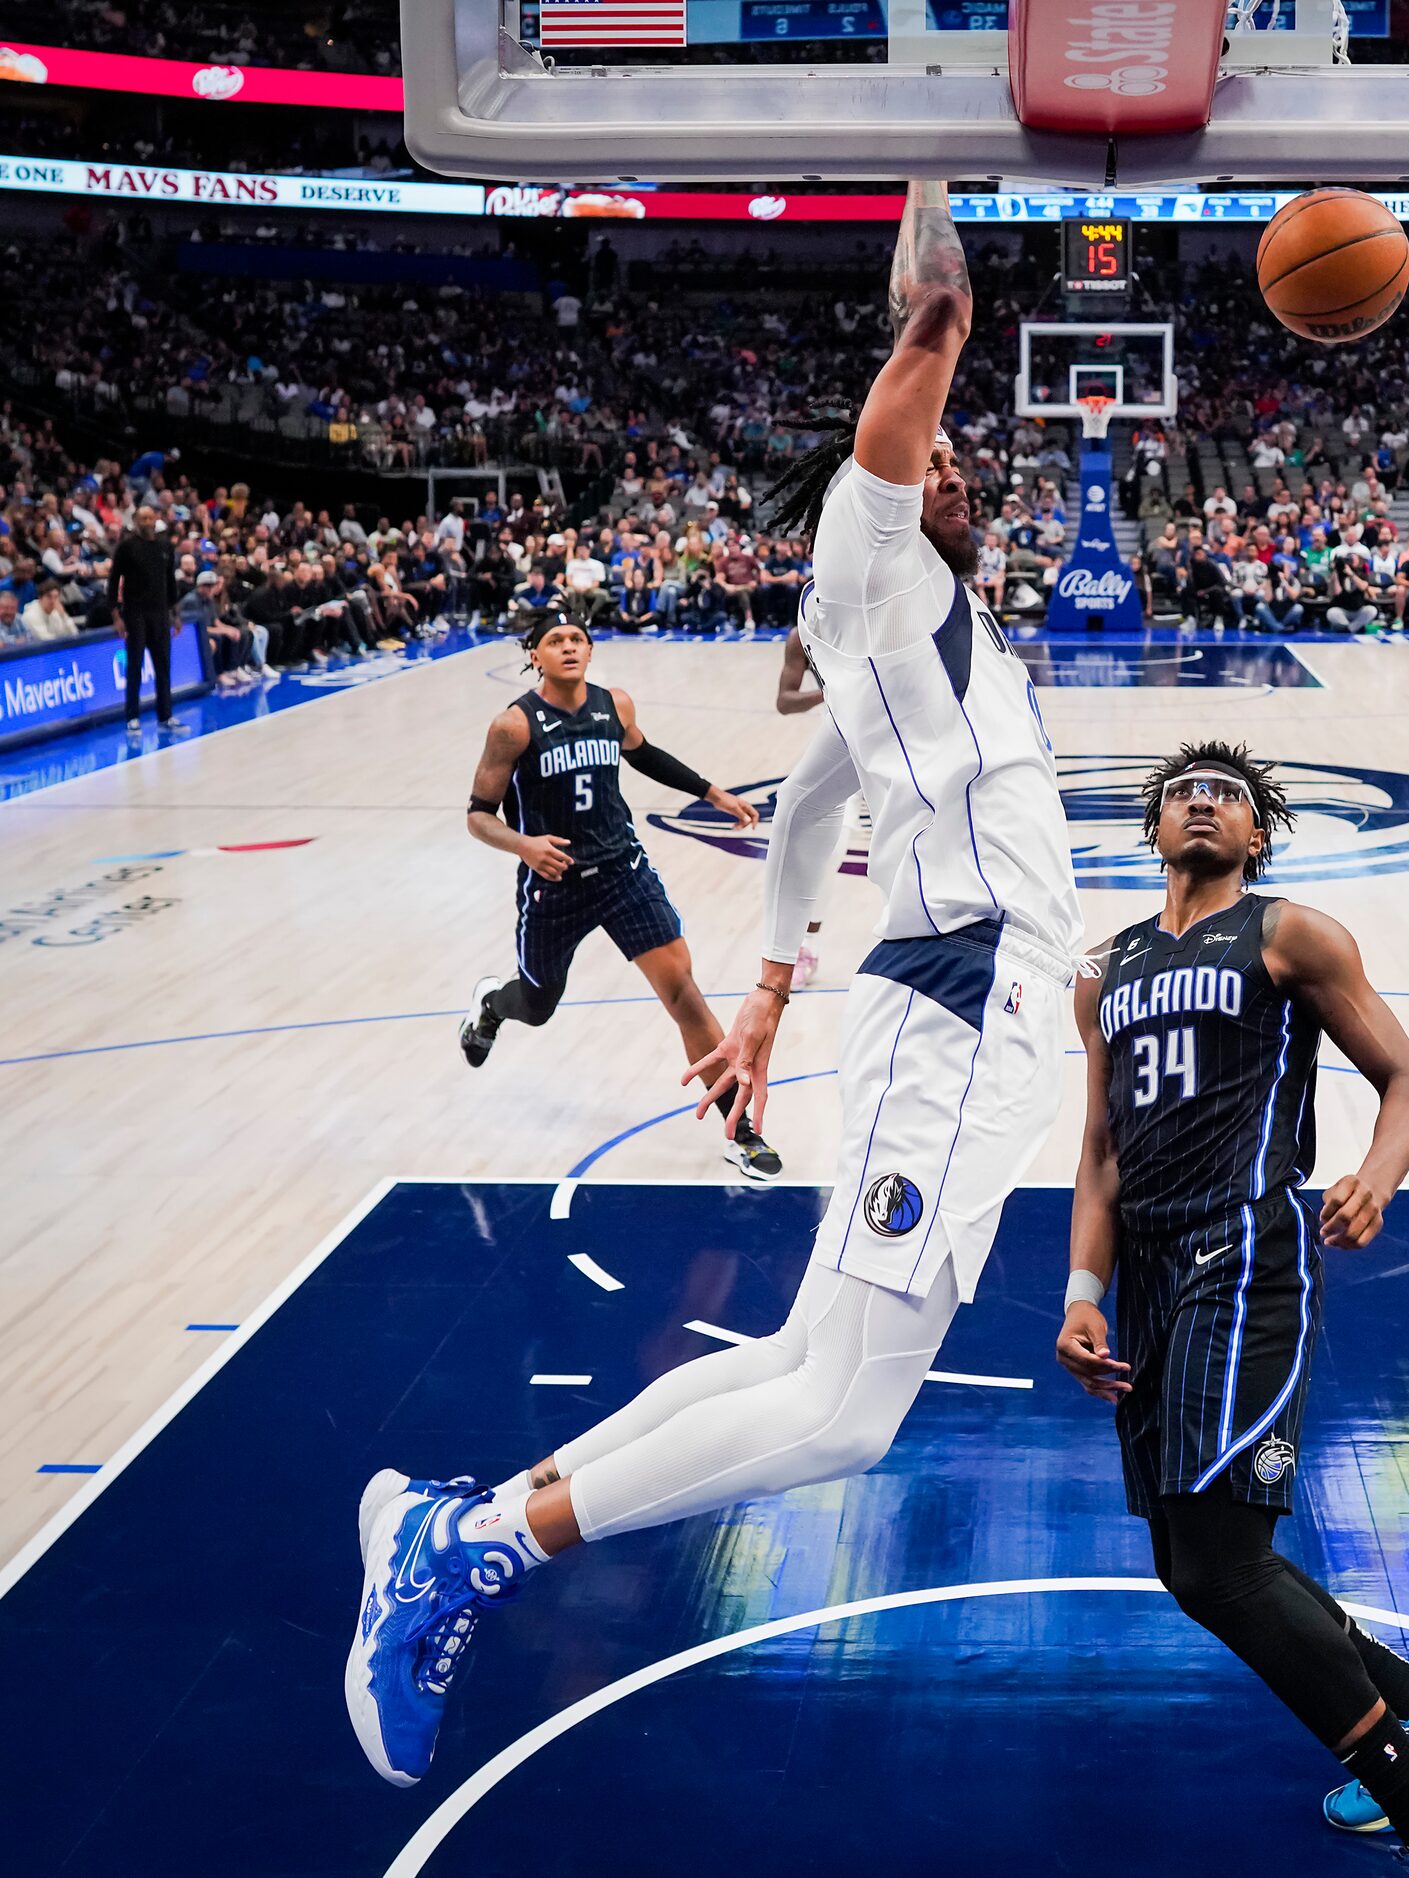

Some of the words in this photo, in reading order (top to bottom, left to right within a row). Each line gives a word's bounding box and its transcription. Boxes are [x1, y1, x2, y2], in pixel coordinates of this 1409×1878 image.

[1064, 1, 1176, 64] State
[15, 165, 64, 183] ONE
[87, 168, 179, 195] MAVS
[193, 175, 278, 201] FANS
[301, 185, 400, 204] DESERVE
[1081, 224, 1122, 241] 4:44
[1088, 243, 1117, 275] 15
[1059, 568, 1132, 605] Bally
[4, 660, 94, 718] Mavericks
[539, 738, 621, 779] ORLANDO
[574, 773, 593, 812] 5
[1202, 932, 1239, 945] Disney
[1099, 965, 1244, 1044] ORLANDO
[1133, 1026, 1198, 1109] 34
